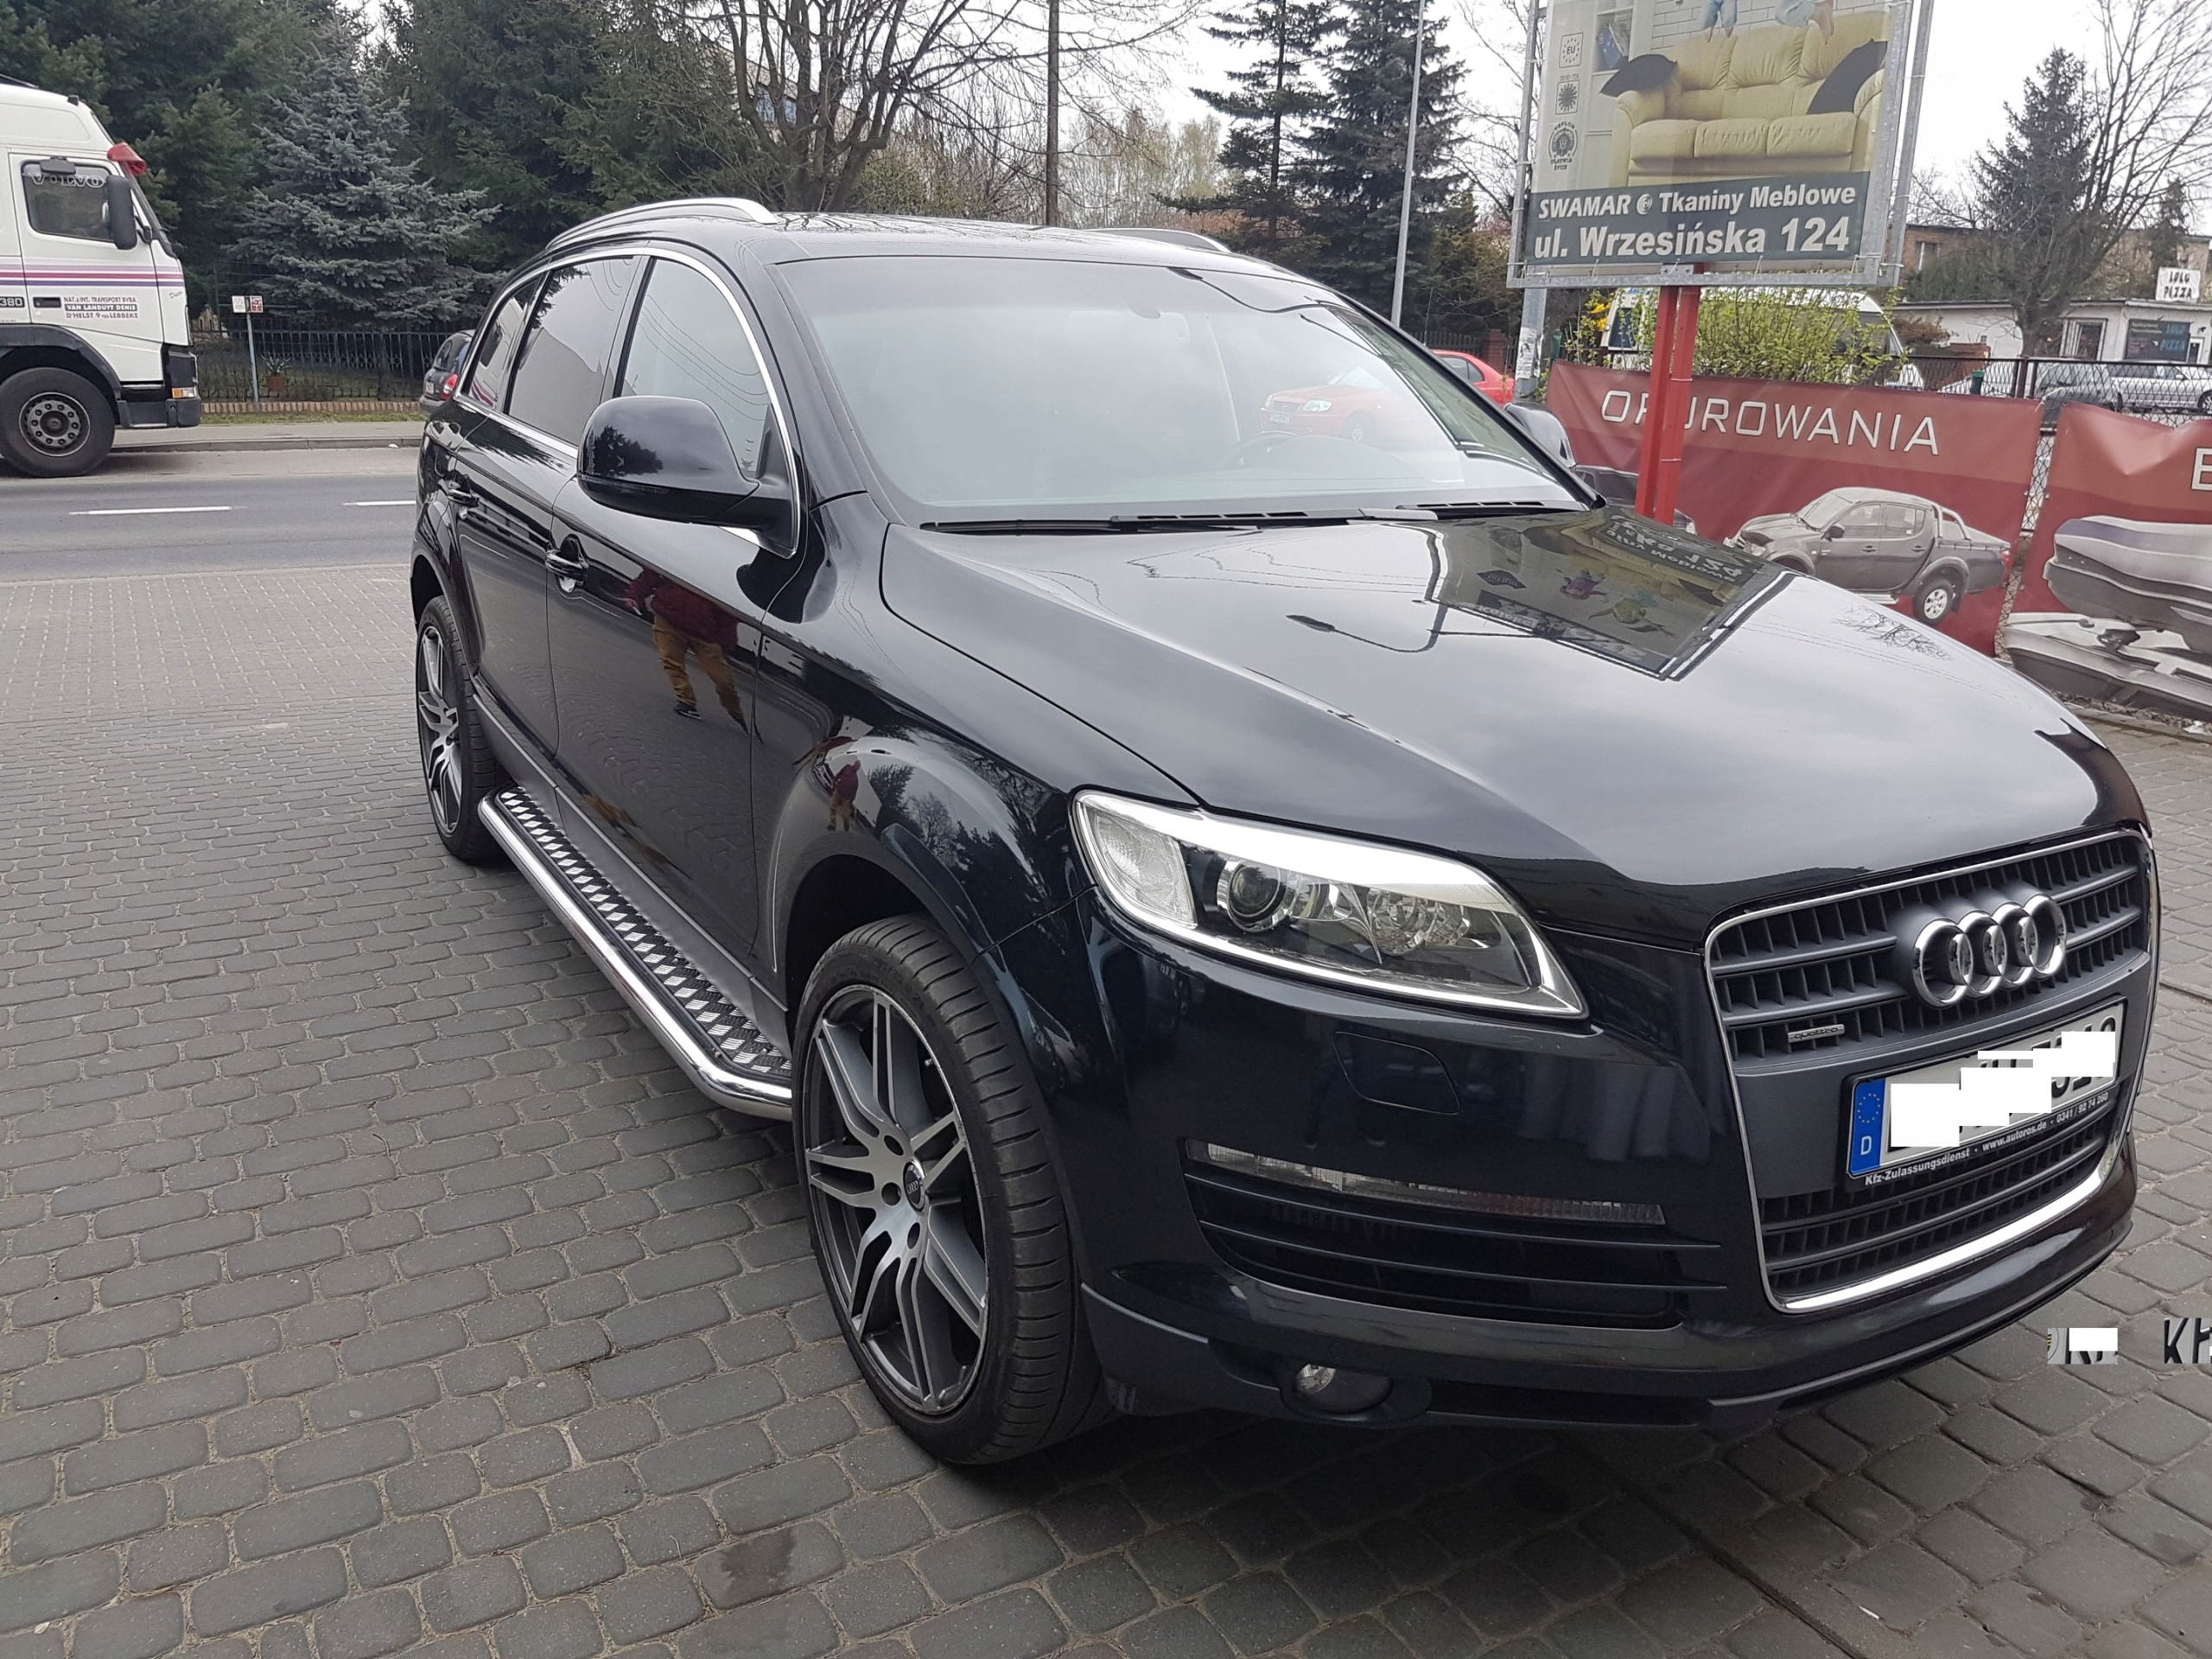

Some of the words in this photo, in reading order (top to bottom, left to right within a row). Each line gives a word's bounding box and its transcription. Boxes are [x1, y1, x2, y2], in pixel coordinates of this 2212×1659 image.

[1538, 194, 1631, 219] SWAMAR
[1658, 189, 1744, 215] Tkaniny
[1749, 183, 1856, 208] Meblowe
[1534, 228, 1568, 258] ul.
[1579, 220, 1766, 257] Wrzesińska
[1781, 216, 1850, 252] 124
[0, 297, 23, 307] 380
[2163, 285, 2192, 300] PIZZA
[1795, 1027, 1839, 1040] quattro
[1860, 1135, 1872, 1155] D
[1865, 1147, 1970, 1186] Kfz-Zulassungsdienst
